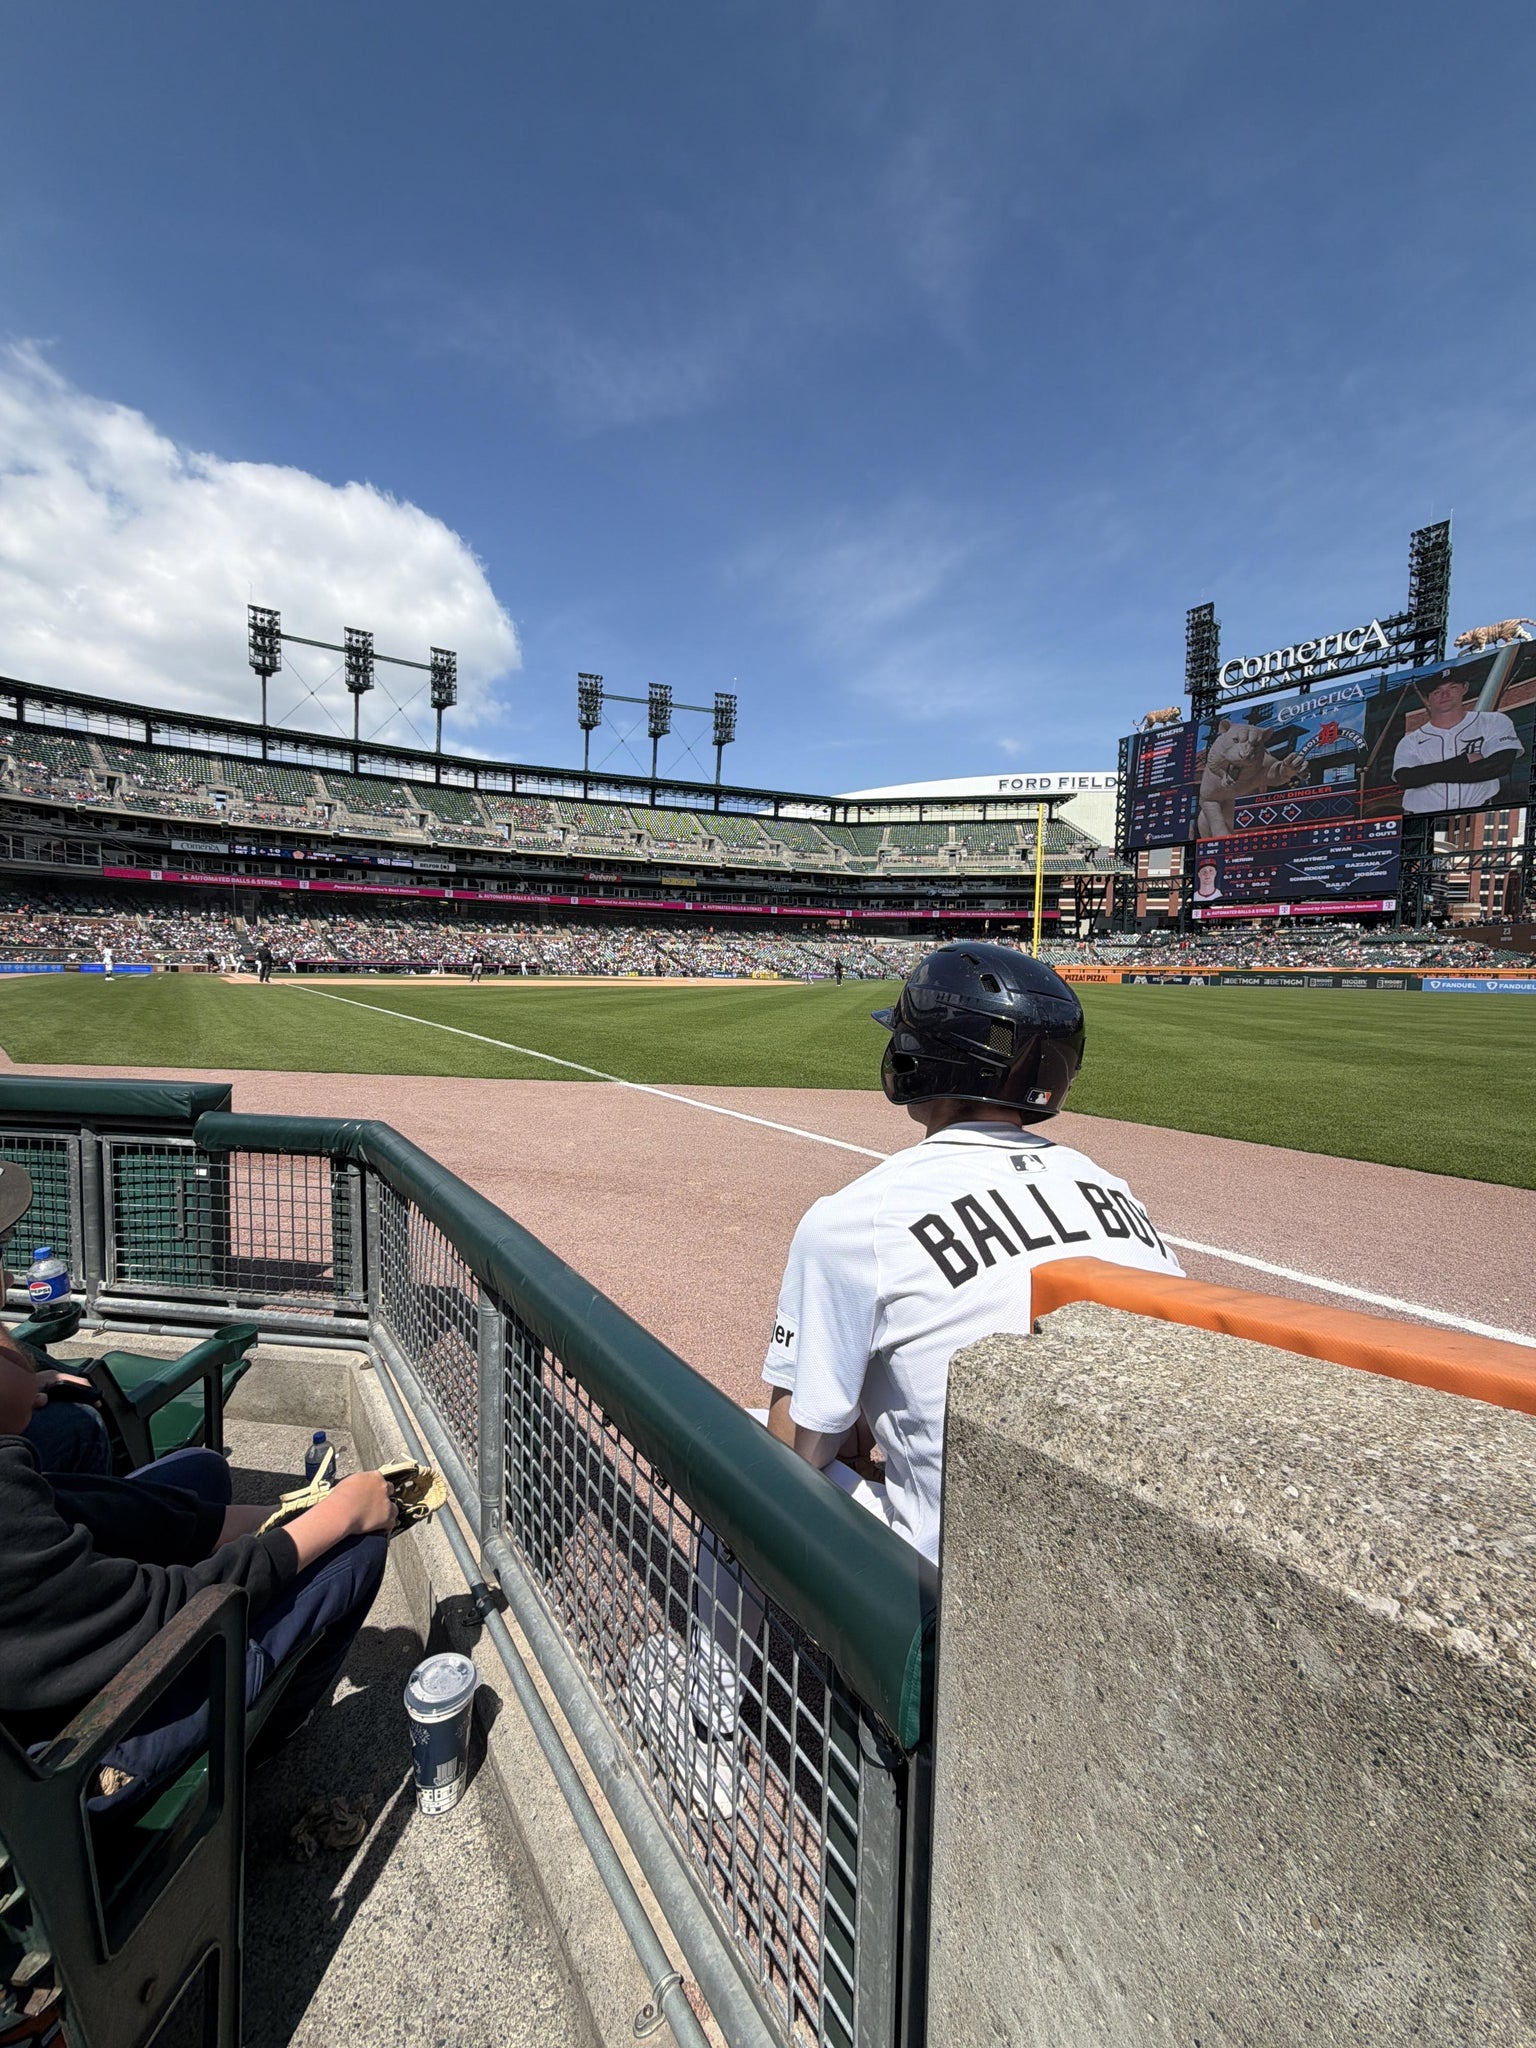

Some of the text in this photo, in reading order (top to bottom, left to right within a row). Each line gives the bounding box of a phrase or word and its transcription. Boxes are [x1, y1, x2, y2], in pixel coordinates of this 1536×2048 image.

[1261, 658, 1340, 687] PARK
[1156, 726, 1184, 738] TIGERS
[1300, 729, 1366, 757] TROIT TIGERS
[998, 776, 1117, 791] FORD FIELD
[1255, 786, 1332, 803] DILLON DINGLER
[1374, 821, 1396, 830] 1-0
[190, 875, 230, 883] AUTOMATED
[1503, 927, 1511, 935] 23
[1065, 974, 1108, 982] PIZZA! PIZZA!
[1270, 978, 1303, 986] BETMGM
[909, 1180, 1168, 1289] BALL BOY
